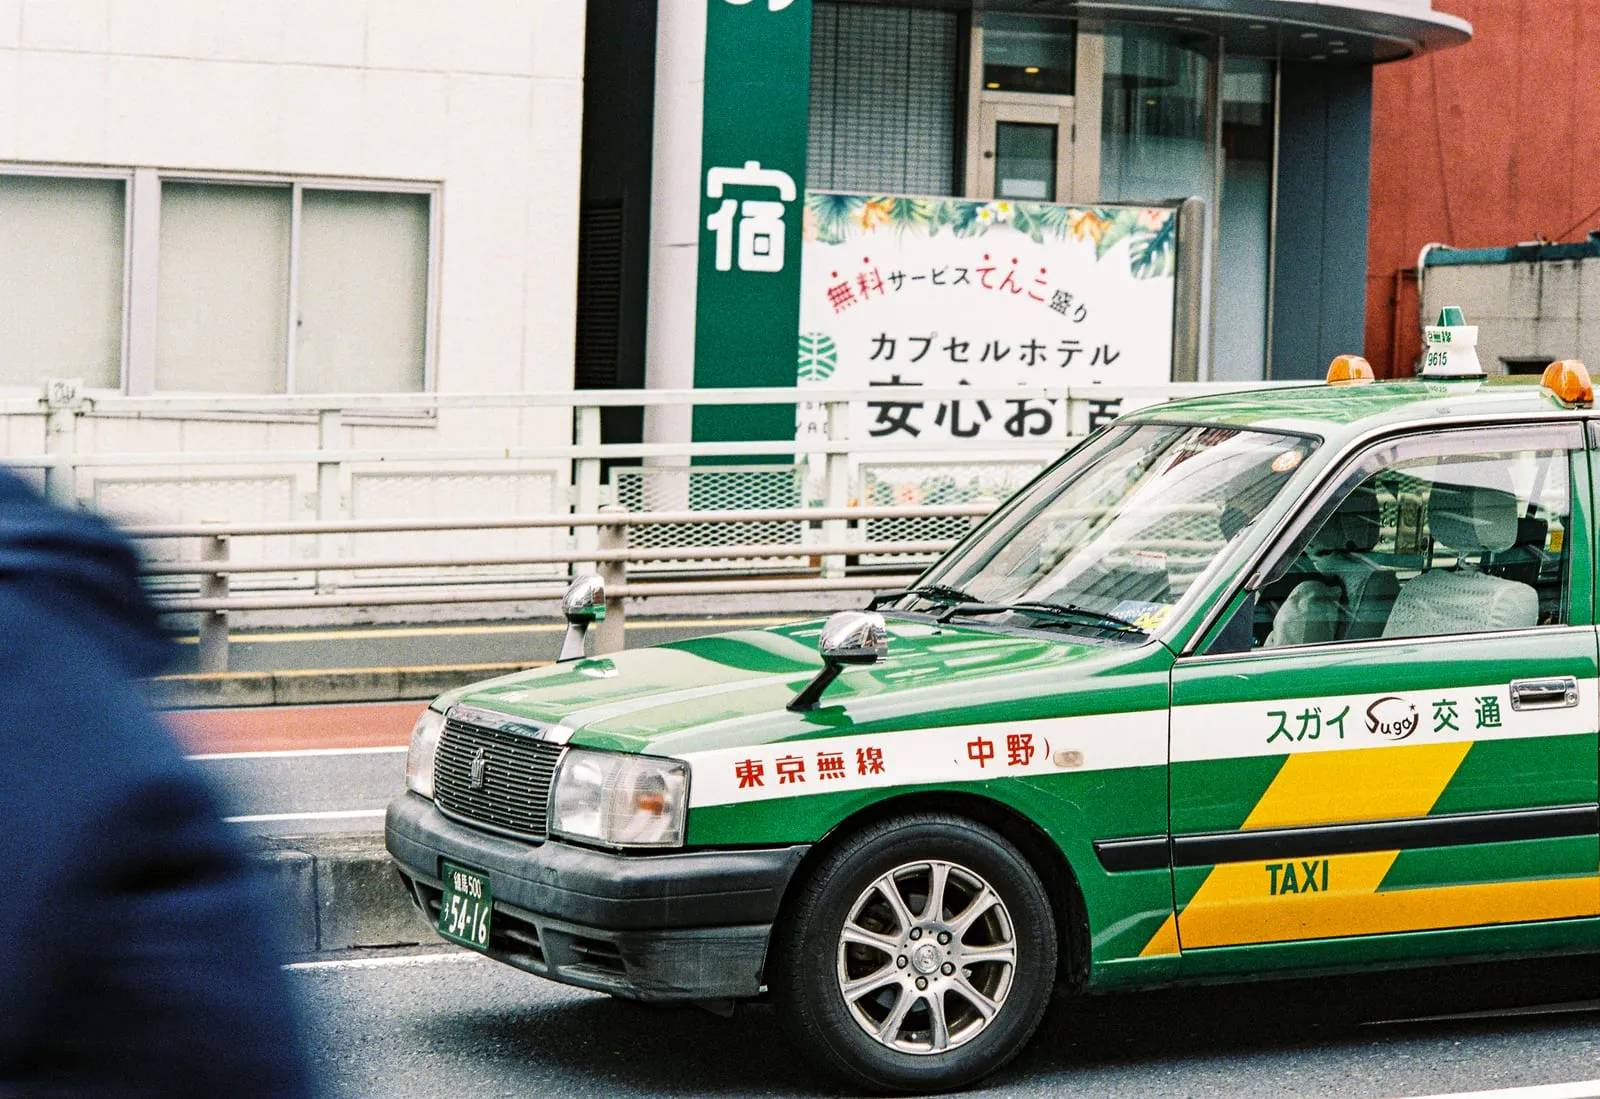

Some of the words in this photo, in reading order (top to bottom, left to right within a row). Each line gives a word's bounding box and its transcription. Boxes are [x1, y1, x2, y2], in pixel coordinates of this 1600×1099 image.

[706, 160, 797, 273] 宿
[868, 331, 1121, 368] カプセルホテル
[1427, 351, 1448, 367] 9615
[1266, 704, 1351, 744] スガイ
[1431, 695, 1503, 732] 交通
[734, 746, 886, 789] 東京無線
[1265, 859, 1330, 896] TAXI
[448, 894, 489, 944] 54-16
